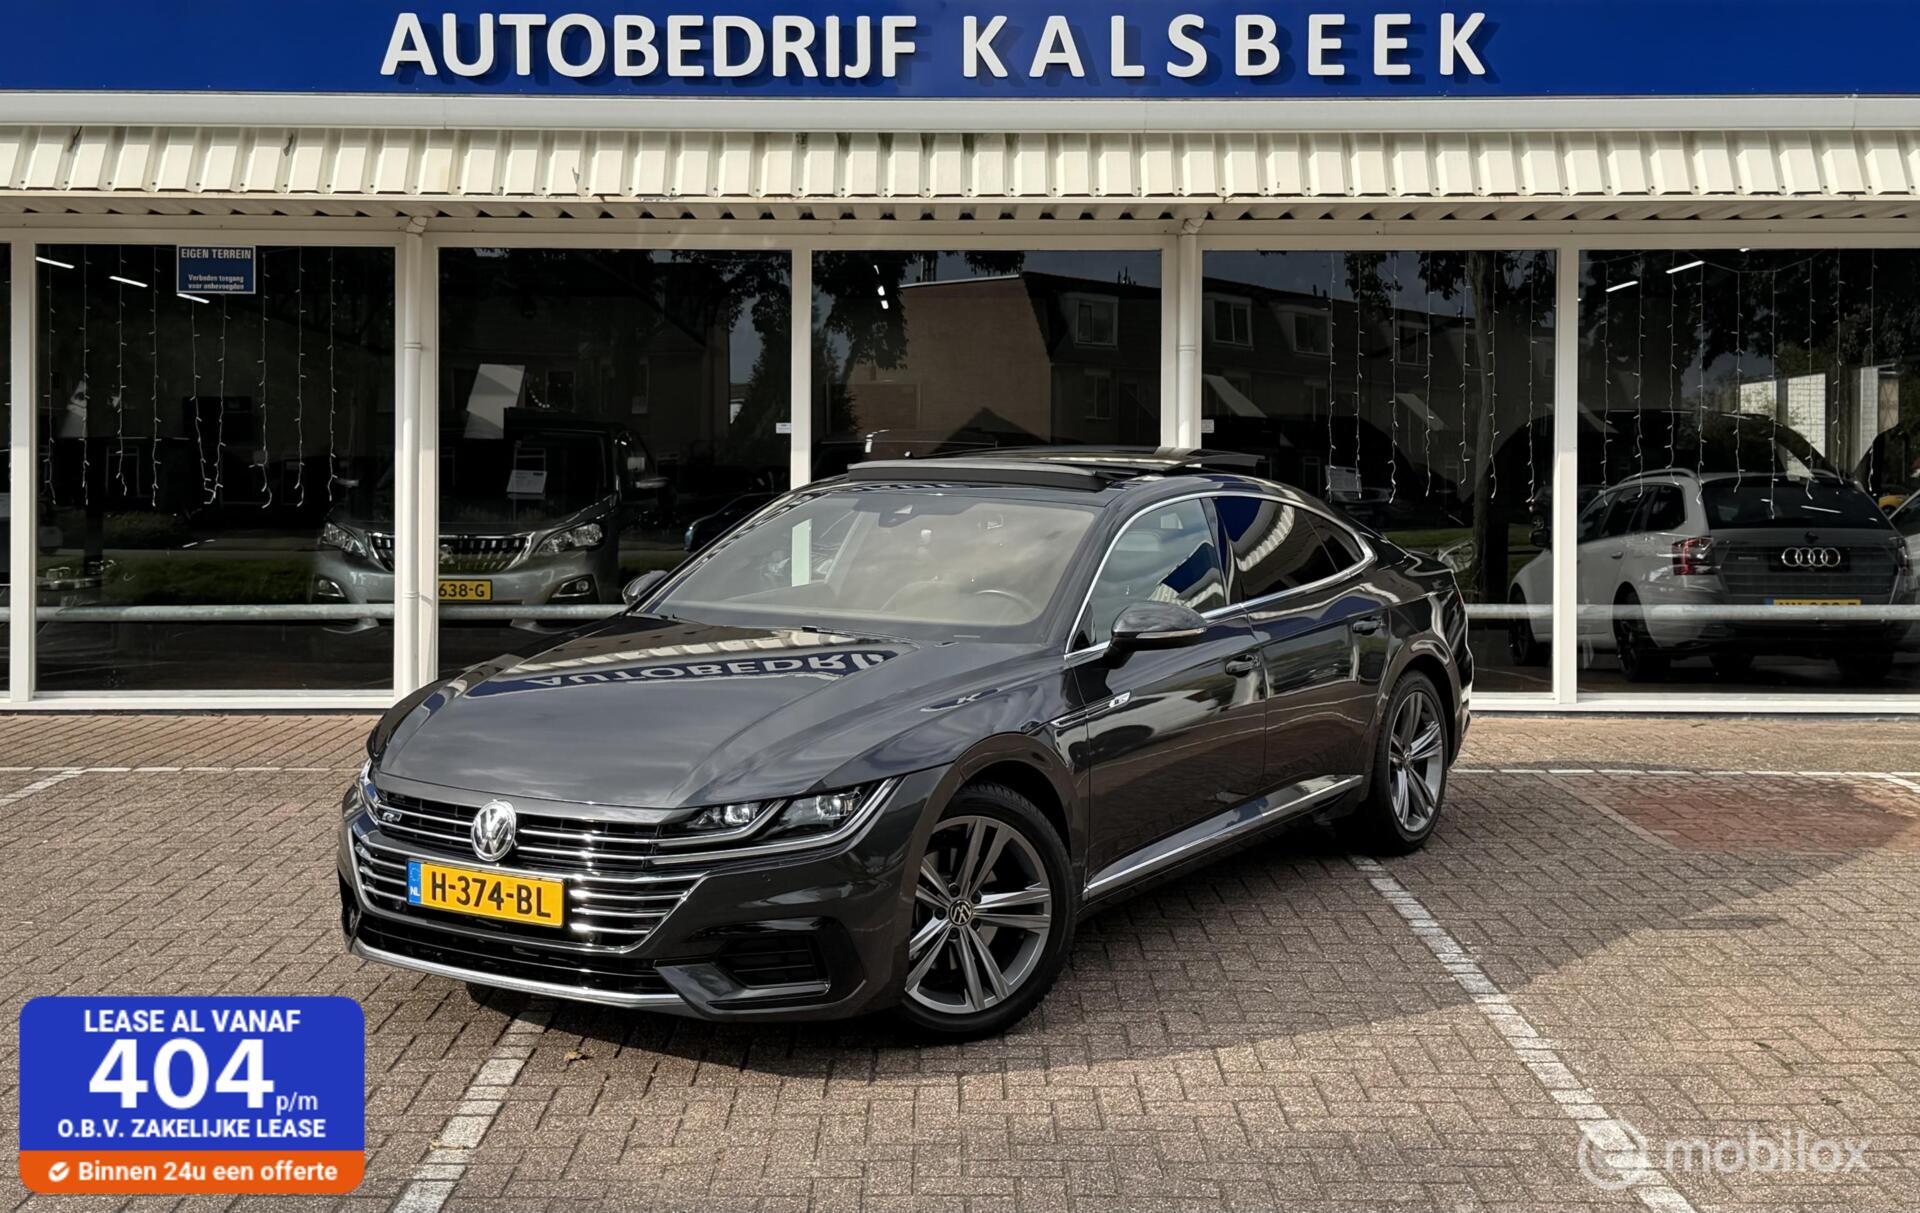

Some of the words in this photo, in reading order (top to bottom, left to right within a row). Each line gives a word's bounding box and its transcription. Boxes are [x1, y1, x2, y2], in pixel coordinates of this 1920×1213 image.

[380, 12, 917, 79] AUTOBEDRIJF
[963, 12, 1486, 79] KALSBEEK
[181, 248, 209, 259] EIGEN
[211, 248, 252, 259] TERREIN
[438, 583, 485, 597] 638-G
[410, 886, 420, 897] NL
[431, 871, 551, 918] H-374-BL
